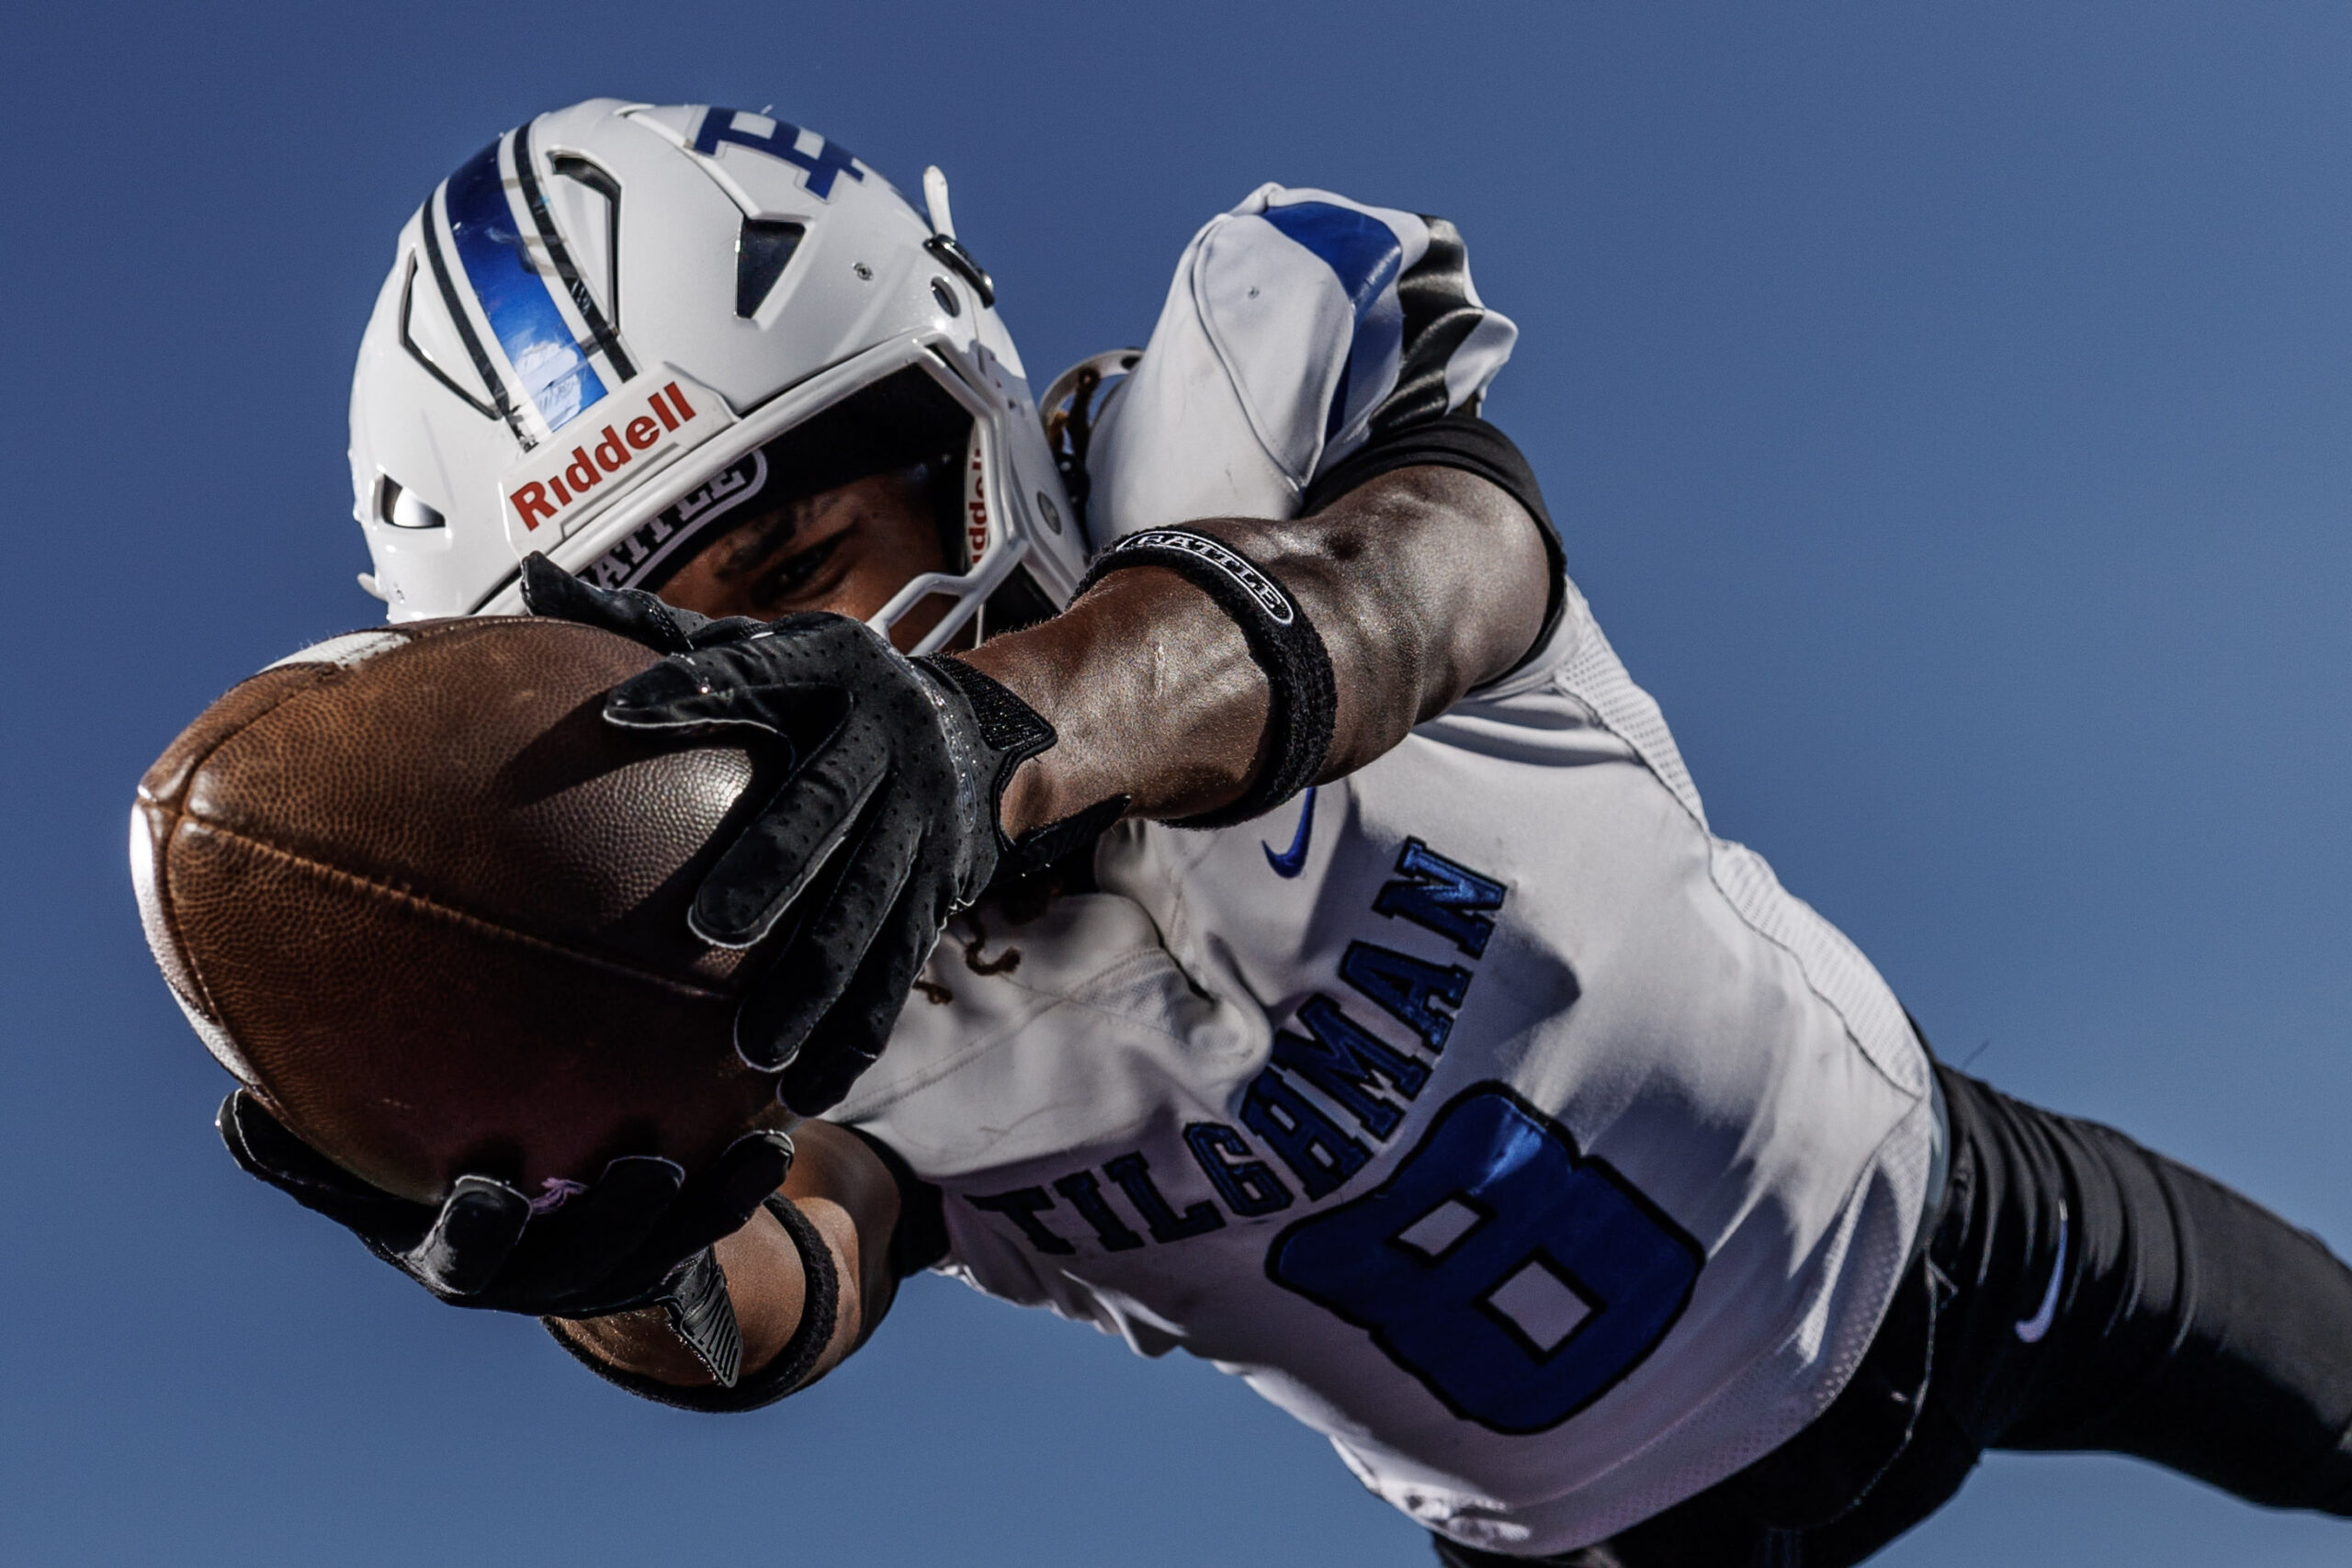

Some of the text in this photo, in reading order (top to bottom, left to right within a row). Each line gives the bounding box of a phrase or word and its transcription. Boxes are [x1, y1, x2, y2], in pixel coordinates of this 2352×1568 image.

[509, 380, 697, 532] Riddell
[579, 468, 747, 589] ATTLE
[963, 835, 1509, 1256] TILGHMAN
[1264, 1078, 1707, 1437] 8
